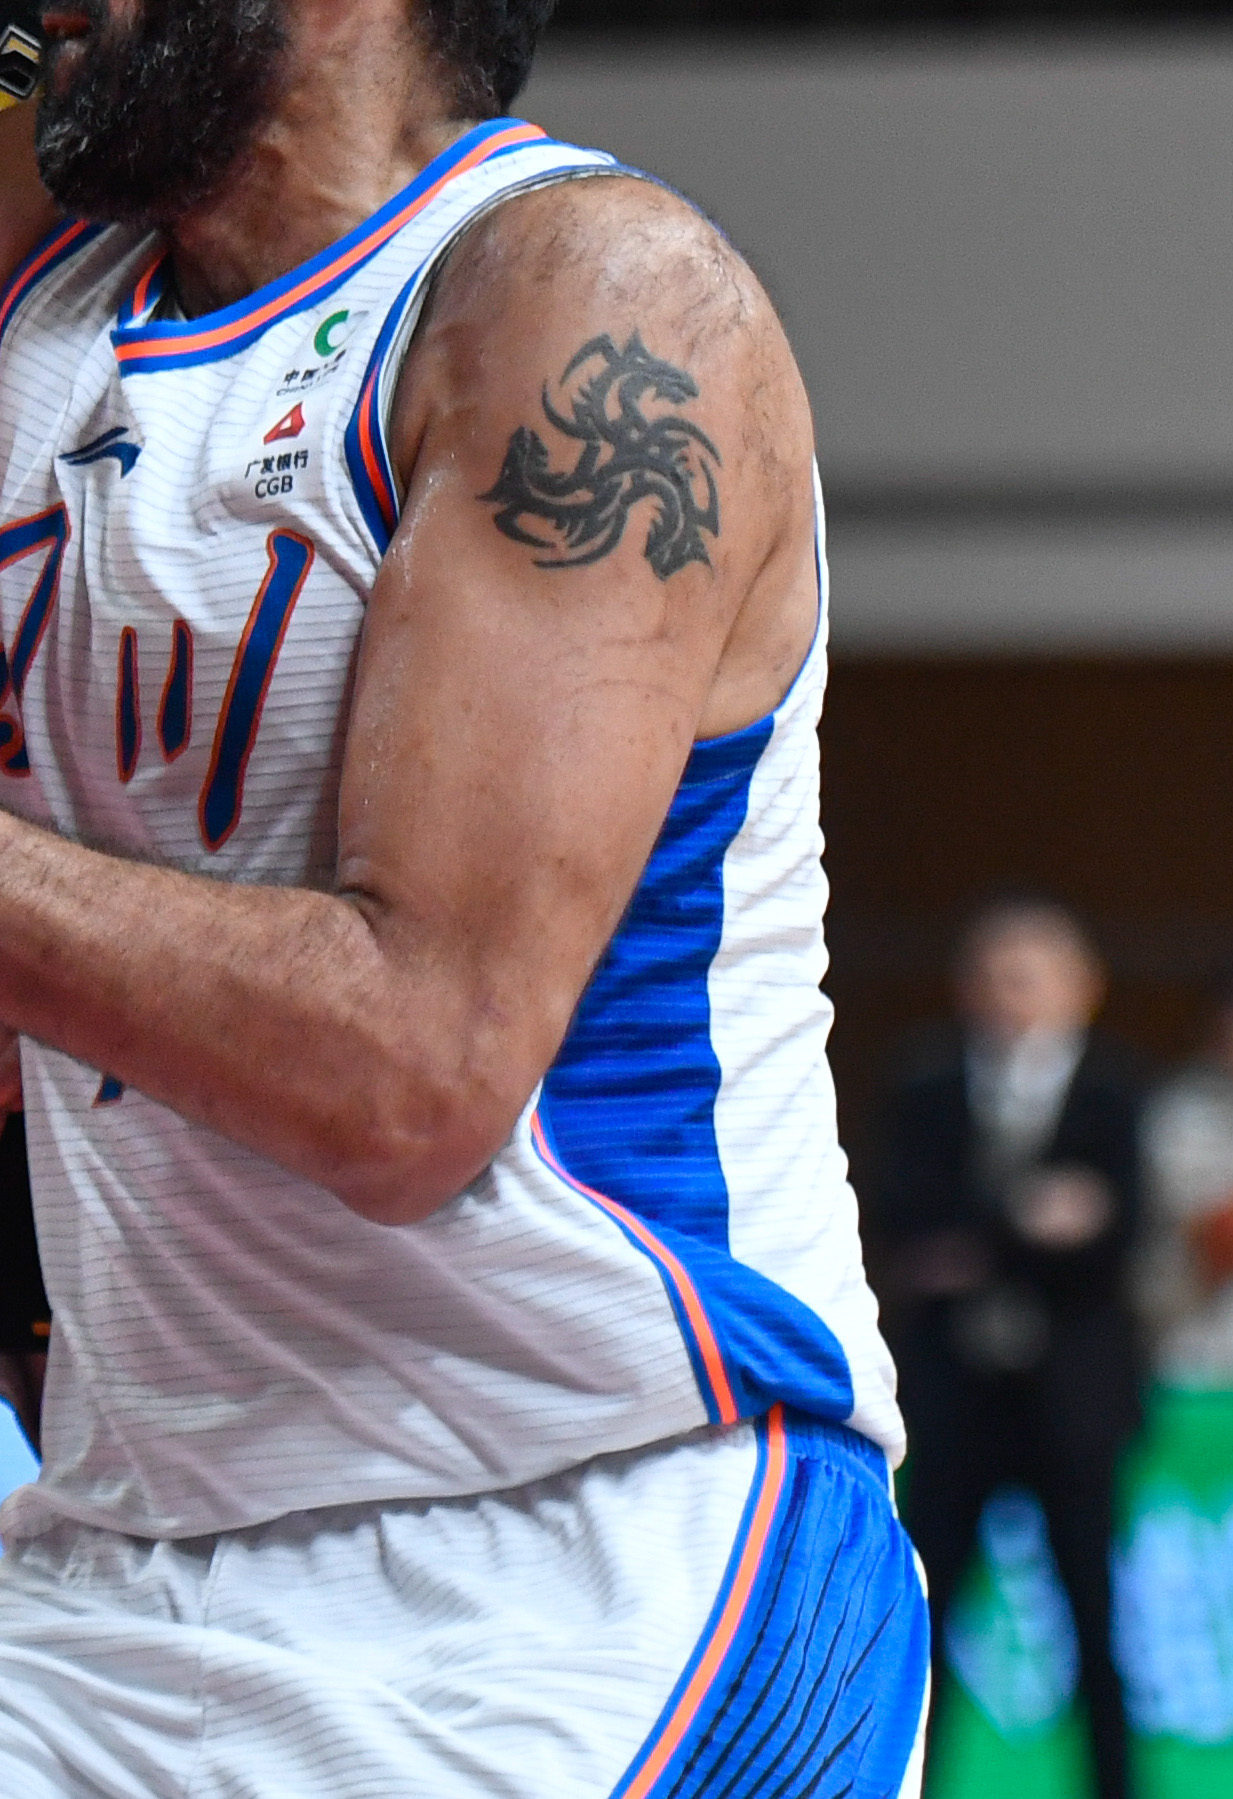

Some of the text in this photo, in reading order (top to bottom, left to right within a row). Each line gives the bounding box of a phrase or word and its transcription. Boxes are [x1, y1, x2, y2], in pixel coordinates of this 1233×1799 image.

[244, 449, 309, 479] 广发银行
[255, 474, 293, 498] CGB
